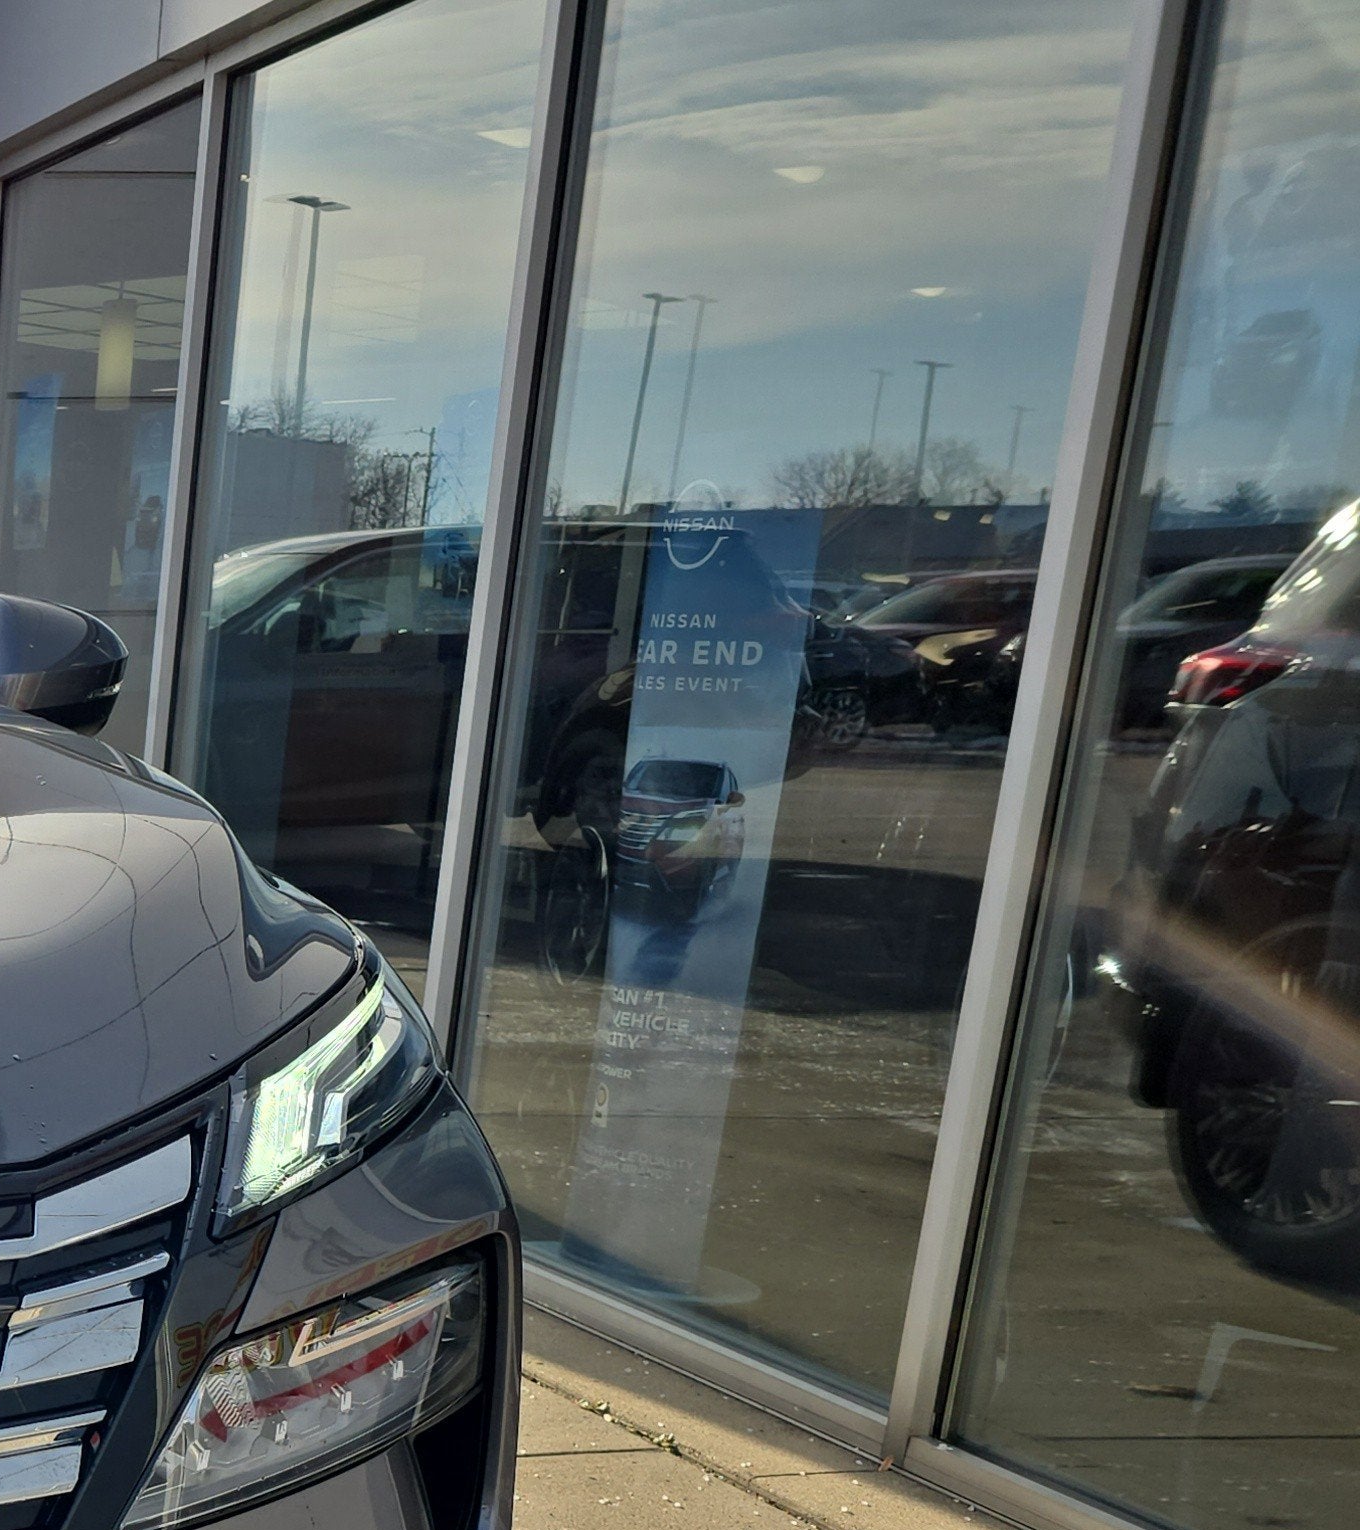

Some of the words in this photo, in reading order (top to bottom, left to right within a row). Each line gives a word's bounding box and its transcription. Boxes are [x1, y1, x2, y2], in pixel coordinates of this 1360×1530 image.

[662, 516, 735, 532] NISSAN
[650, 613, 716, 629] NISSAN
[692, 640, 764, 666] END
[675, 677, 742, 692] EVENT
